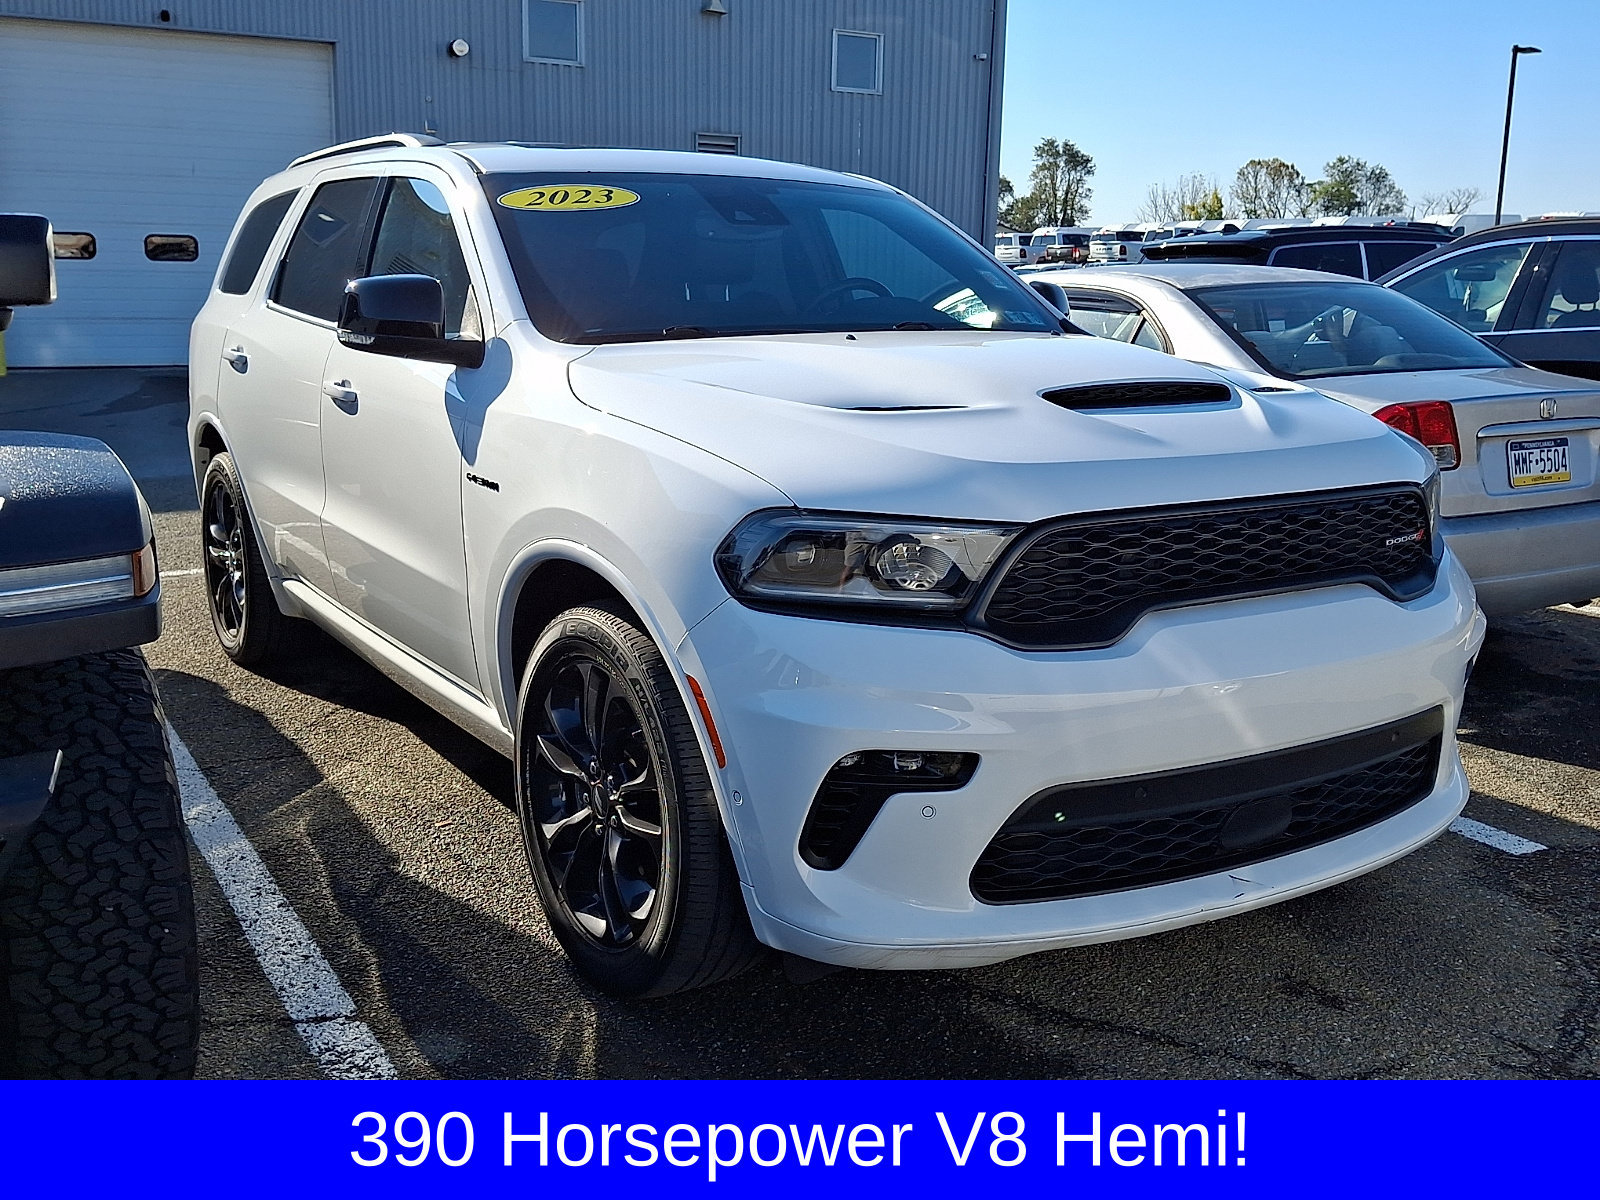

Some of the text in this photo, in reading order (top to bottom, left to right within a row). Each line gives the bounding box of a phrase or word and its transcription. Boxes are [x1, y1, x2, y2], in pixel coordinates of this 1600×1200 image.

[524, 188, 614, 207] 2023
[1386, 532, 1419, 545] DODGE
[565, 621, 630, 673] ECOPIA
